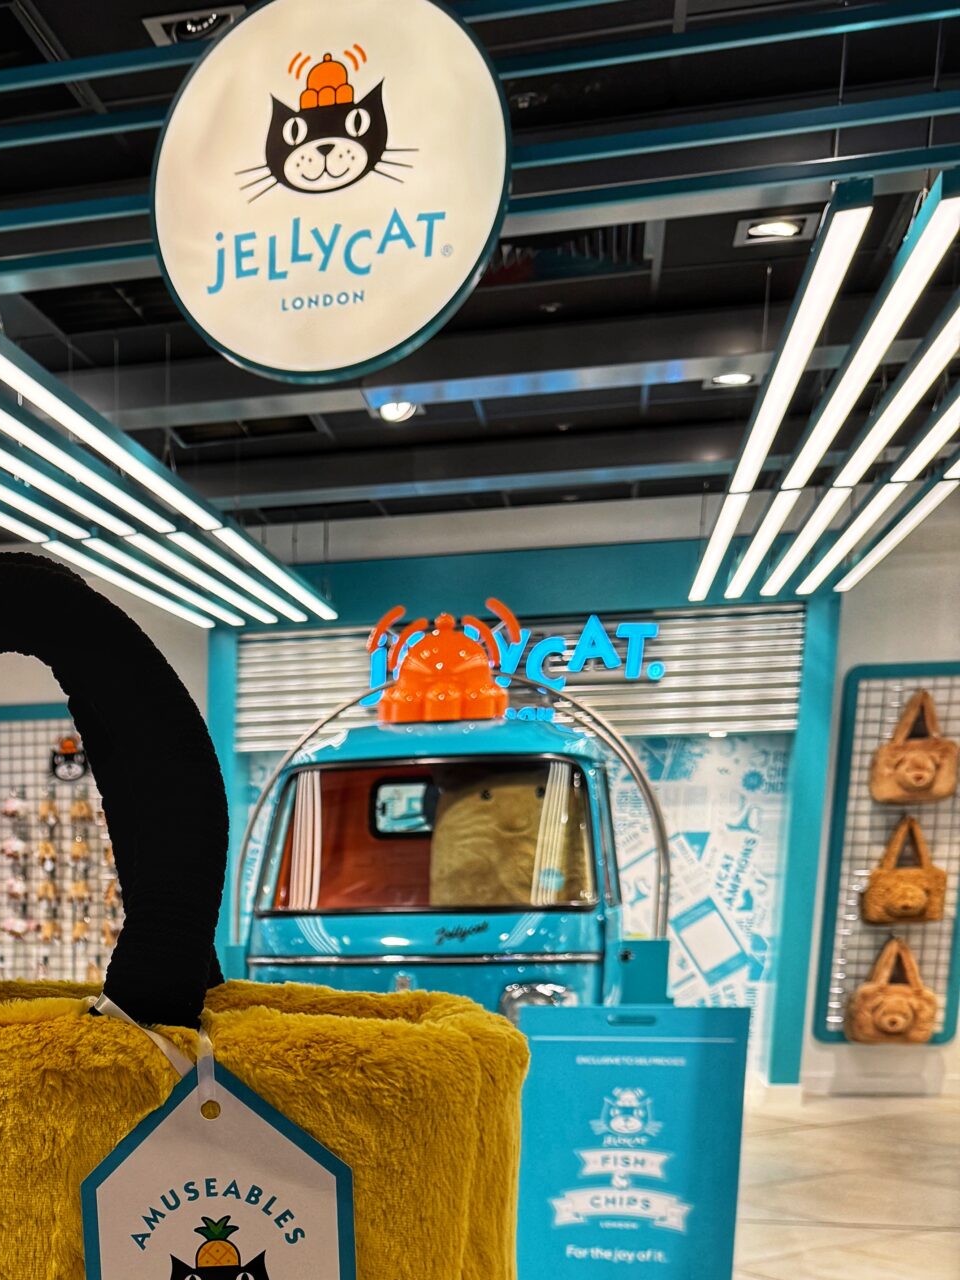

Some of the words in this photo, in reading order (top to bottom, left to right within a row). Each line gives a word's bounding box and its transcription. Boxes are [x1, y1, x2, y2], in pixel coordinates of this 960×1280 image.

[281, 290, 366, 312] LONDON
[601, 1156, 647, 1168] FISH
[590, 1196, 651, 1210] CHIPS
[130, 1177, 306, 1250] AMUSEABLES
[566, 1244, 587, 1259] For
[590, 1247, 612, 1260] the
[613, 1249, 635, 1263] joy
[636, 1249, 652, 1262] of
[653, 1250, 669, 1263] it.
